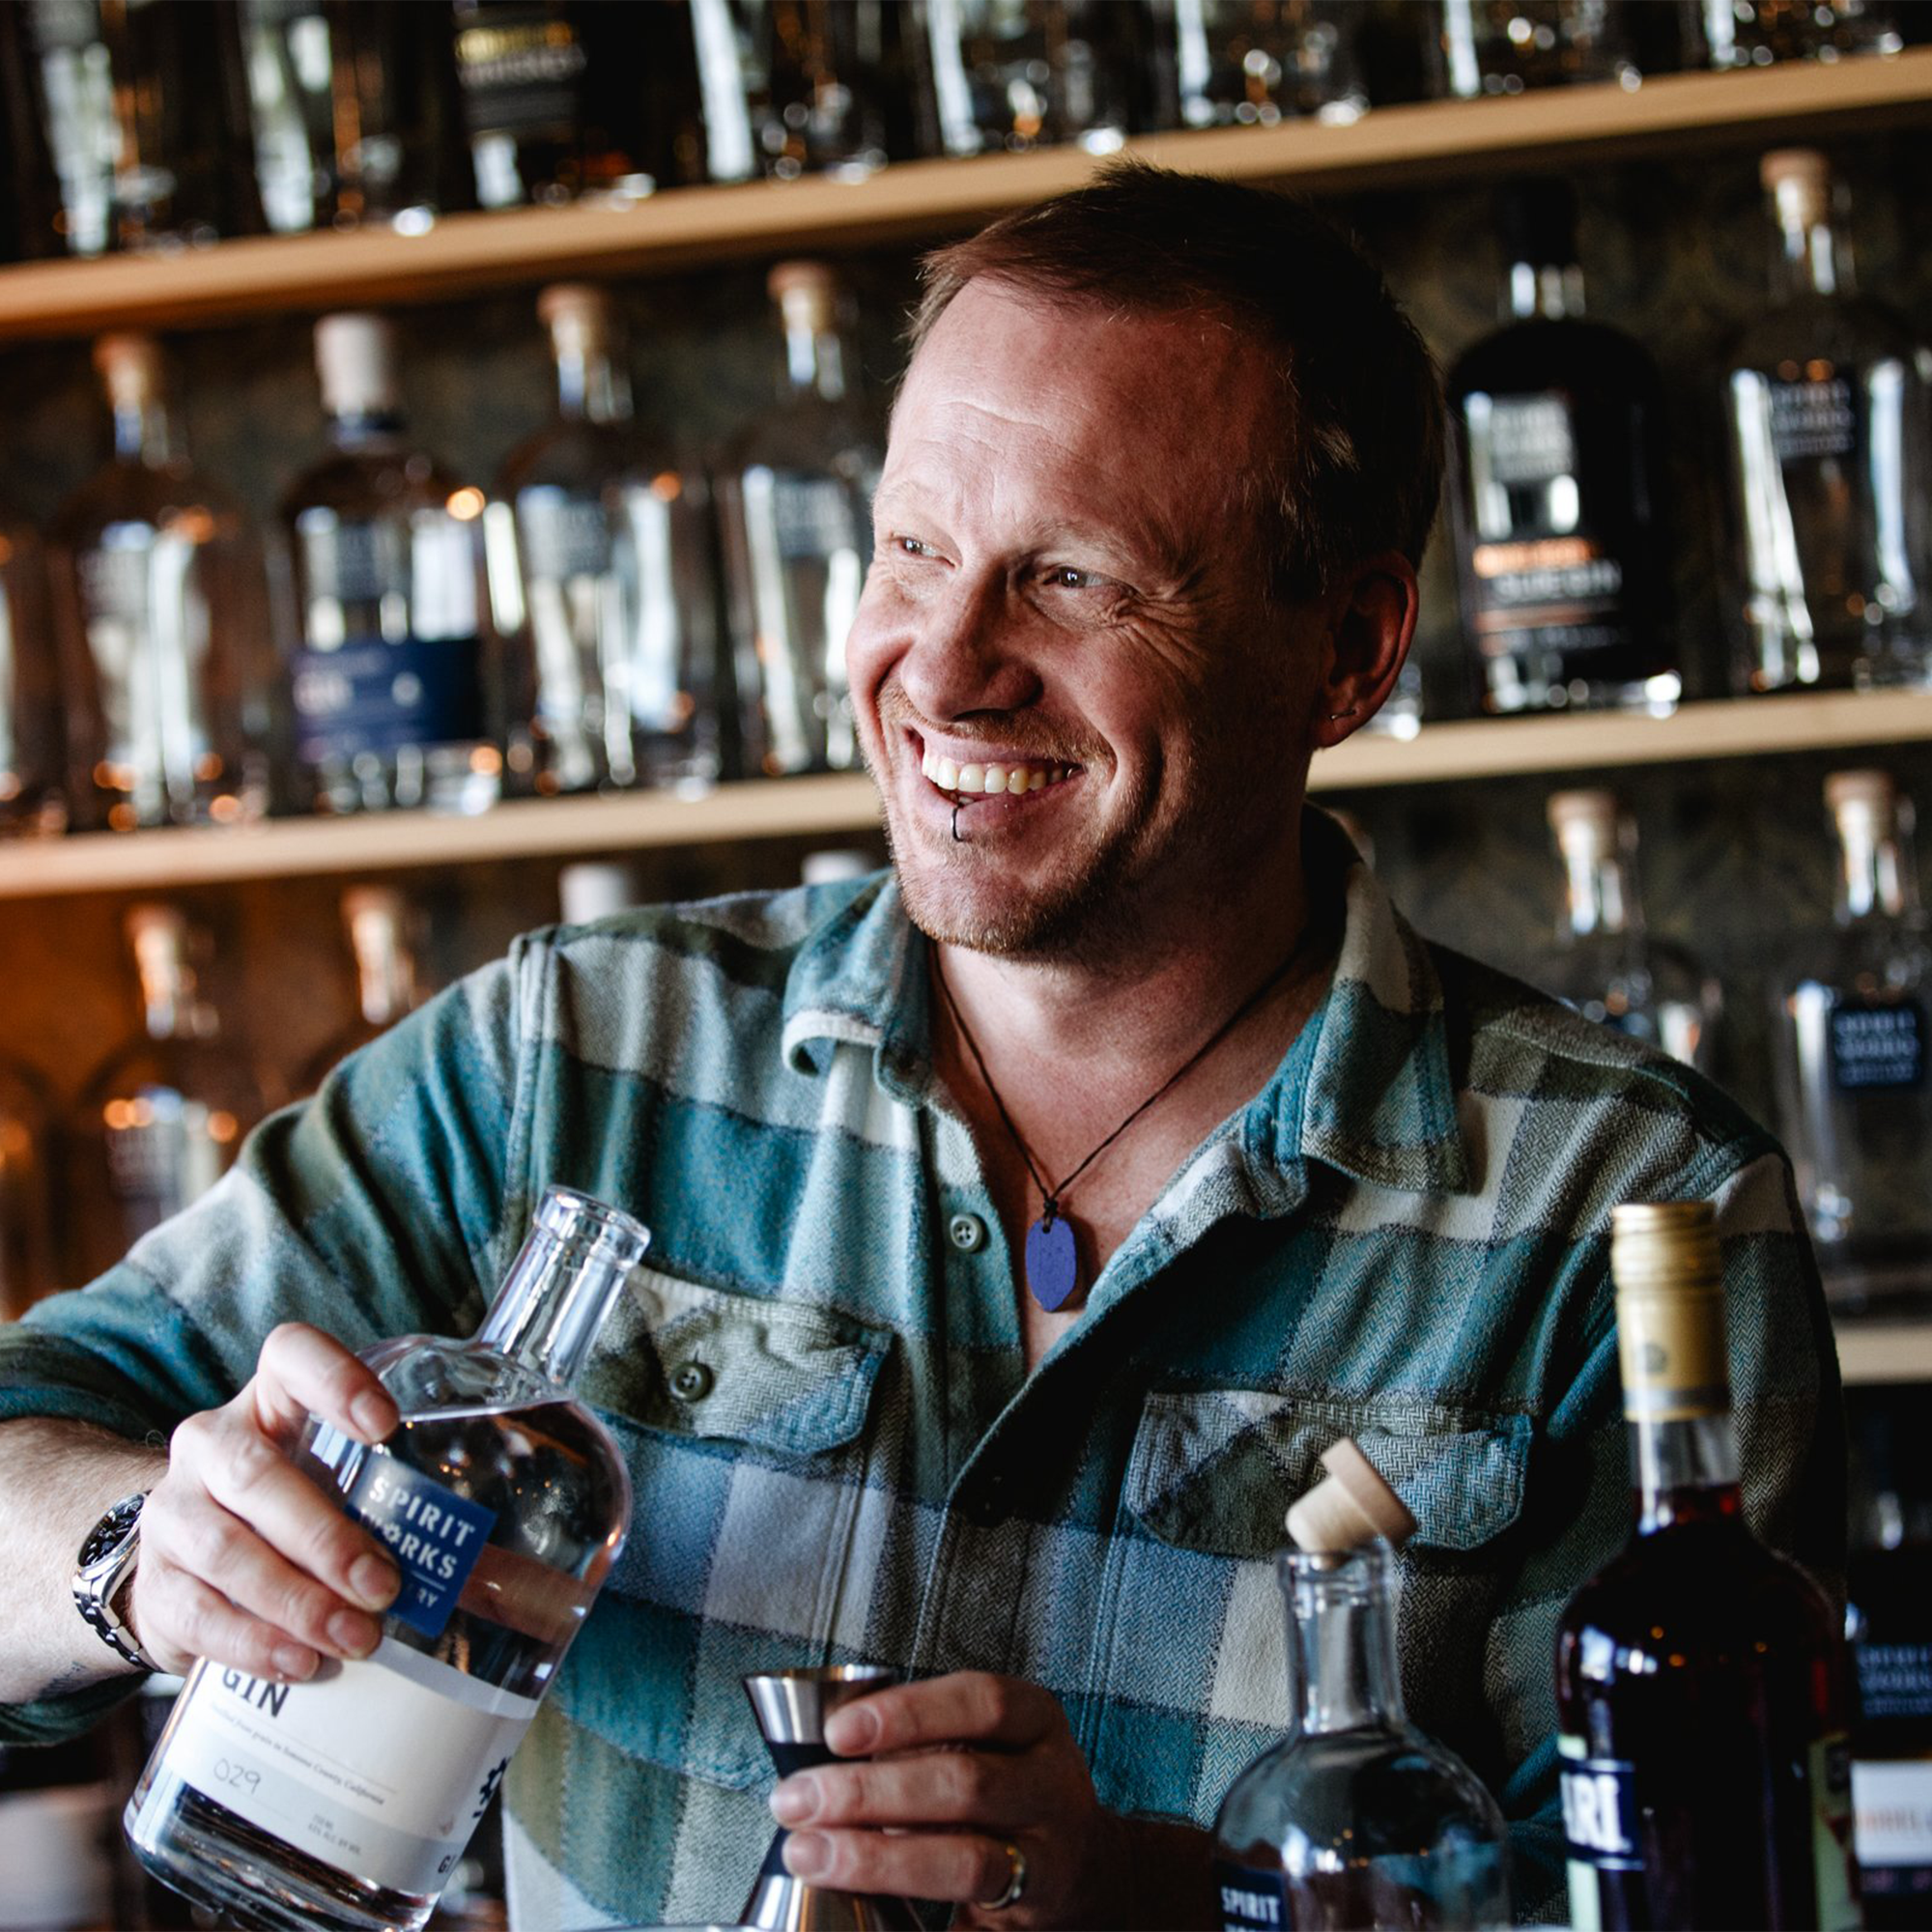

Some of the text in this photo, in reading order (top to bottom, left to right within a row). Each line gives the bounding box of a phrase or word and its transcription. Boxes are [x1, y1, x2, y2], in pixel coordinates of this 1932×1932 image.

[368, 1475, 475, 1548] SPIRIT
[222, 1668, 290, 1719] GIN
[213, 1757, 262, 1795] 029
[1220, 1887, 1279, 1924] SPIRIT
